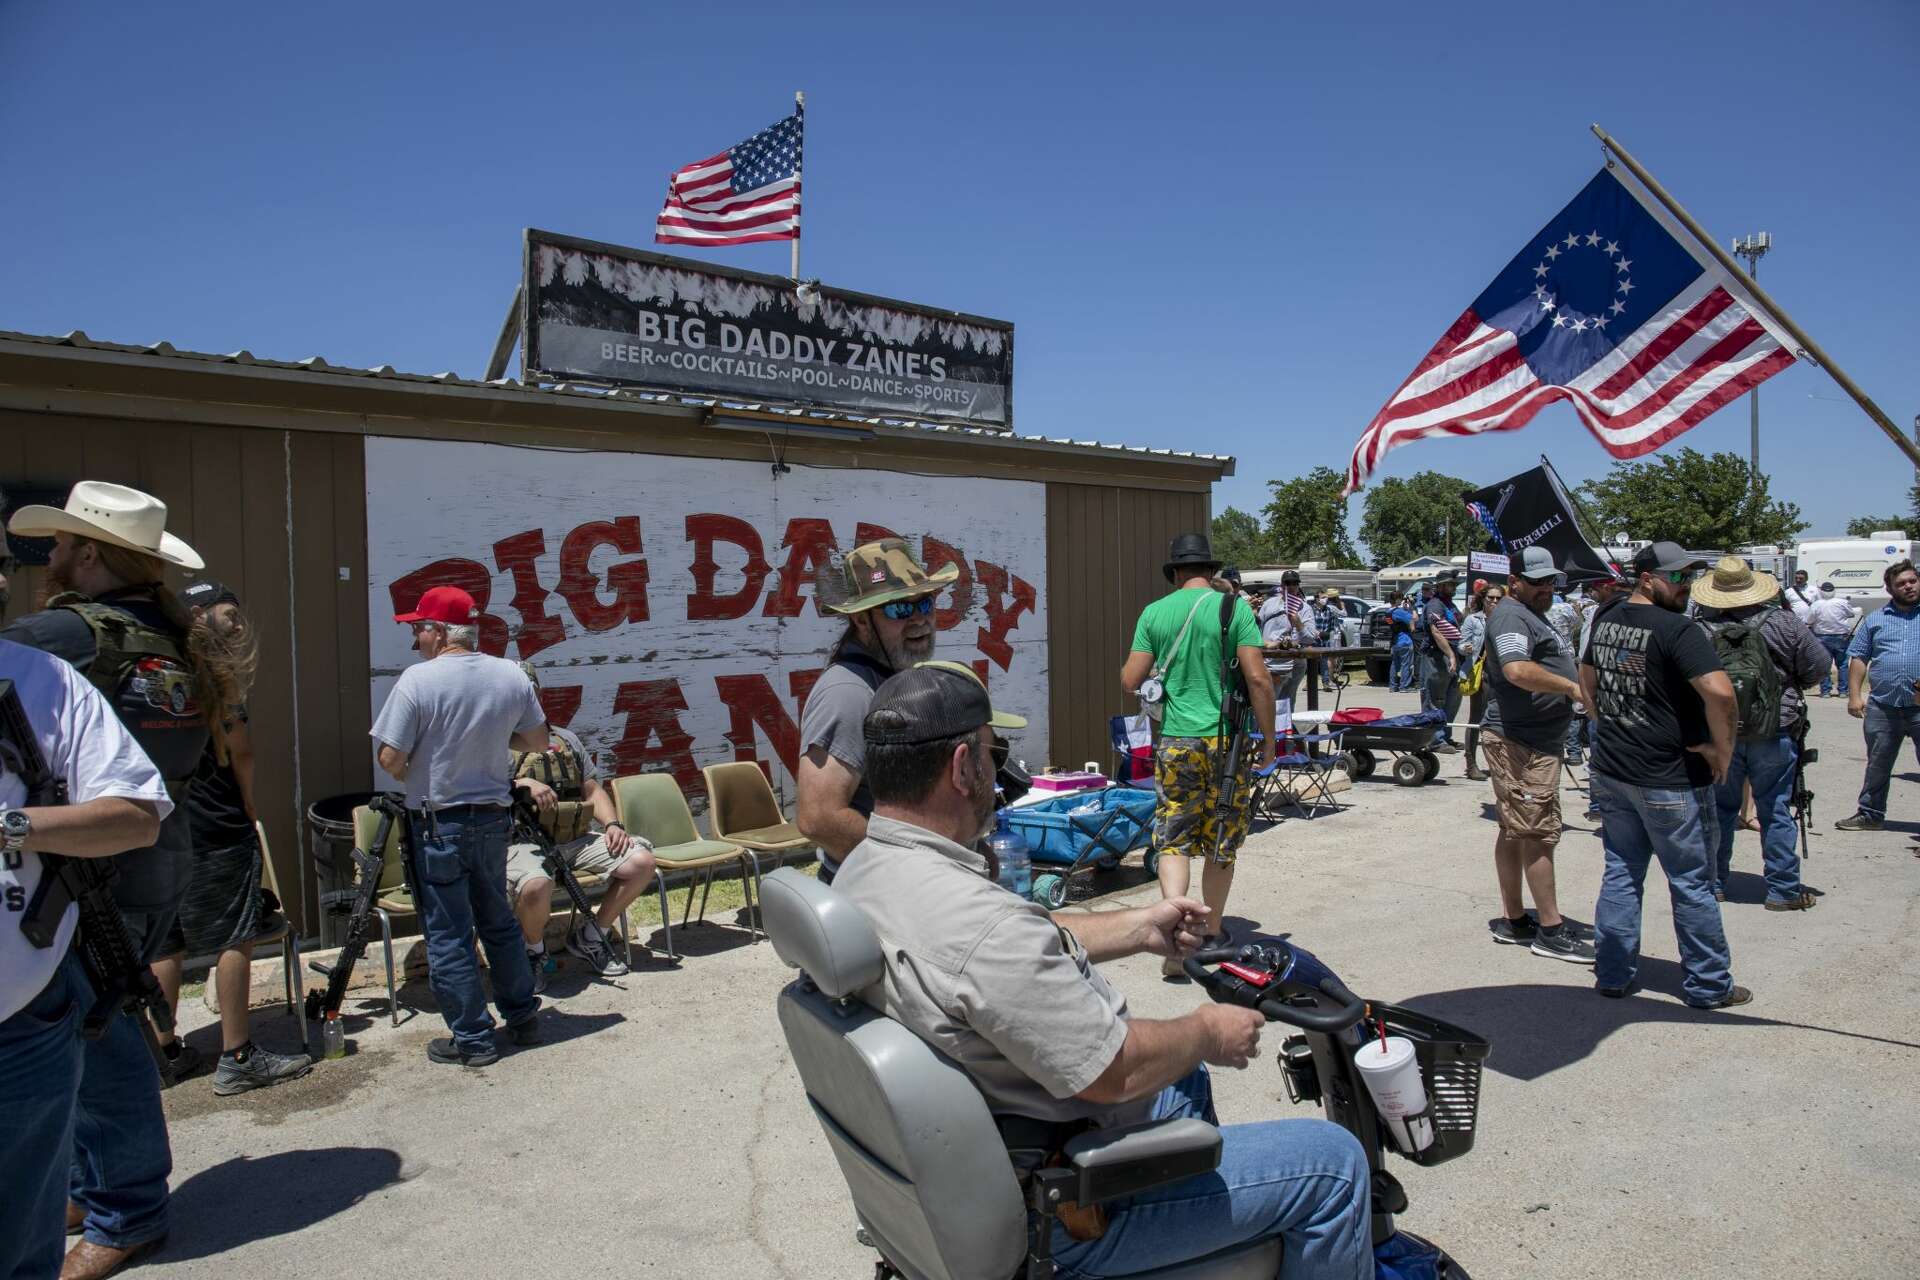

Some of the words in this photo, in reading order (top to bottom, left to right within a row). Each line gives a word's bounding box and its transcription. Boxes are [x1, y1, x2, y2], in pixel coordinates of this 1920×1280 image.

[639, 310, 706, 349] BIG
[720, 323, 837, 367] DADDY
[846, 343, 946, 383] ZANE'S
